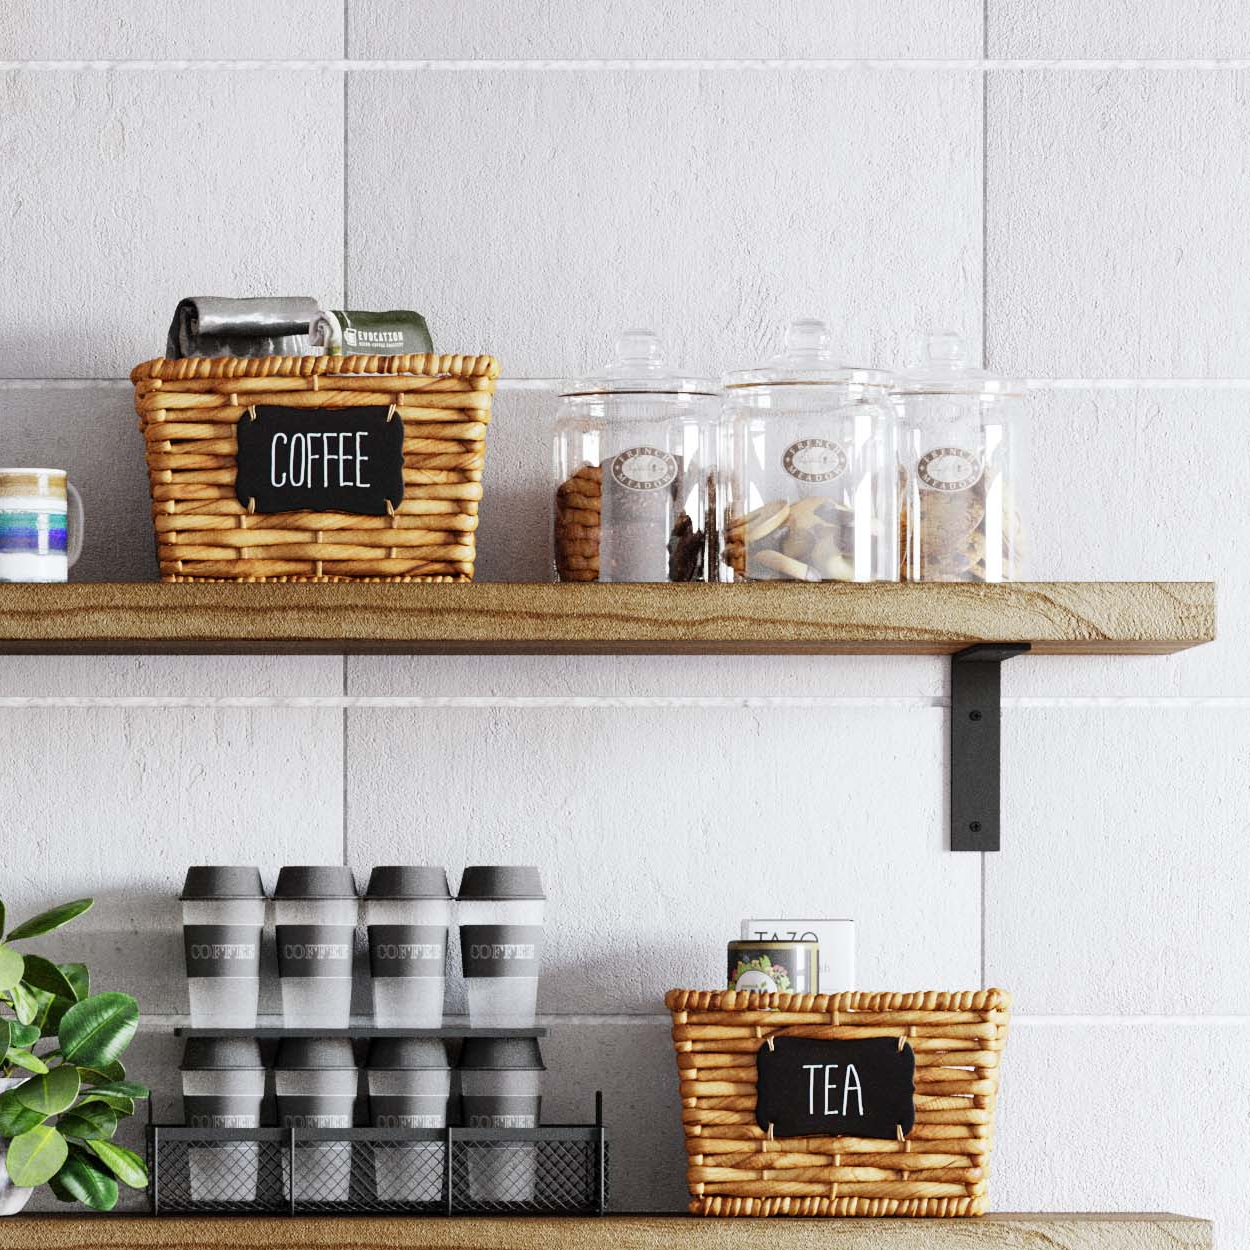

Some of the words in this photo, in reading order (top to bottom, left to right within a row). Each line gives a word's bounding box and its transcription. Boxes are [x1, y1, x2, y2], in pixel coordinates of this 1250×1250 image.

[358, 331, 403, 342] EVOCATION
[271, 432, 371, 488] COFFEE
[191, 944, 256, 960] COFFEE
[285, 944, 350, 960] COFFEE
[376, 944, 442, 960] COFFEE
[470, 944, 535, 960] COFFEE
[802, 1064, 864, 1116] TEA
